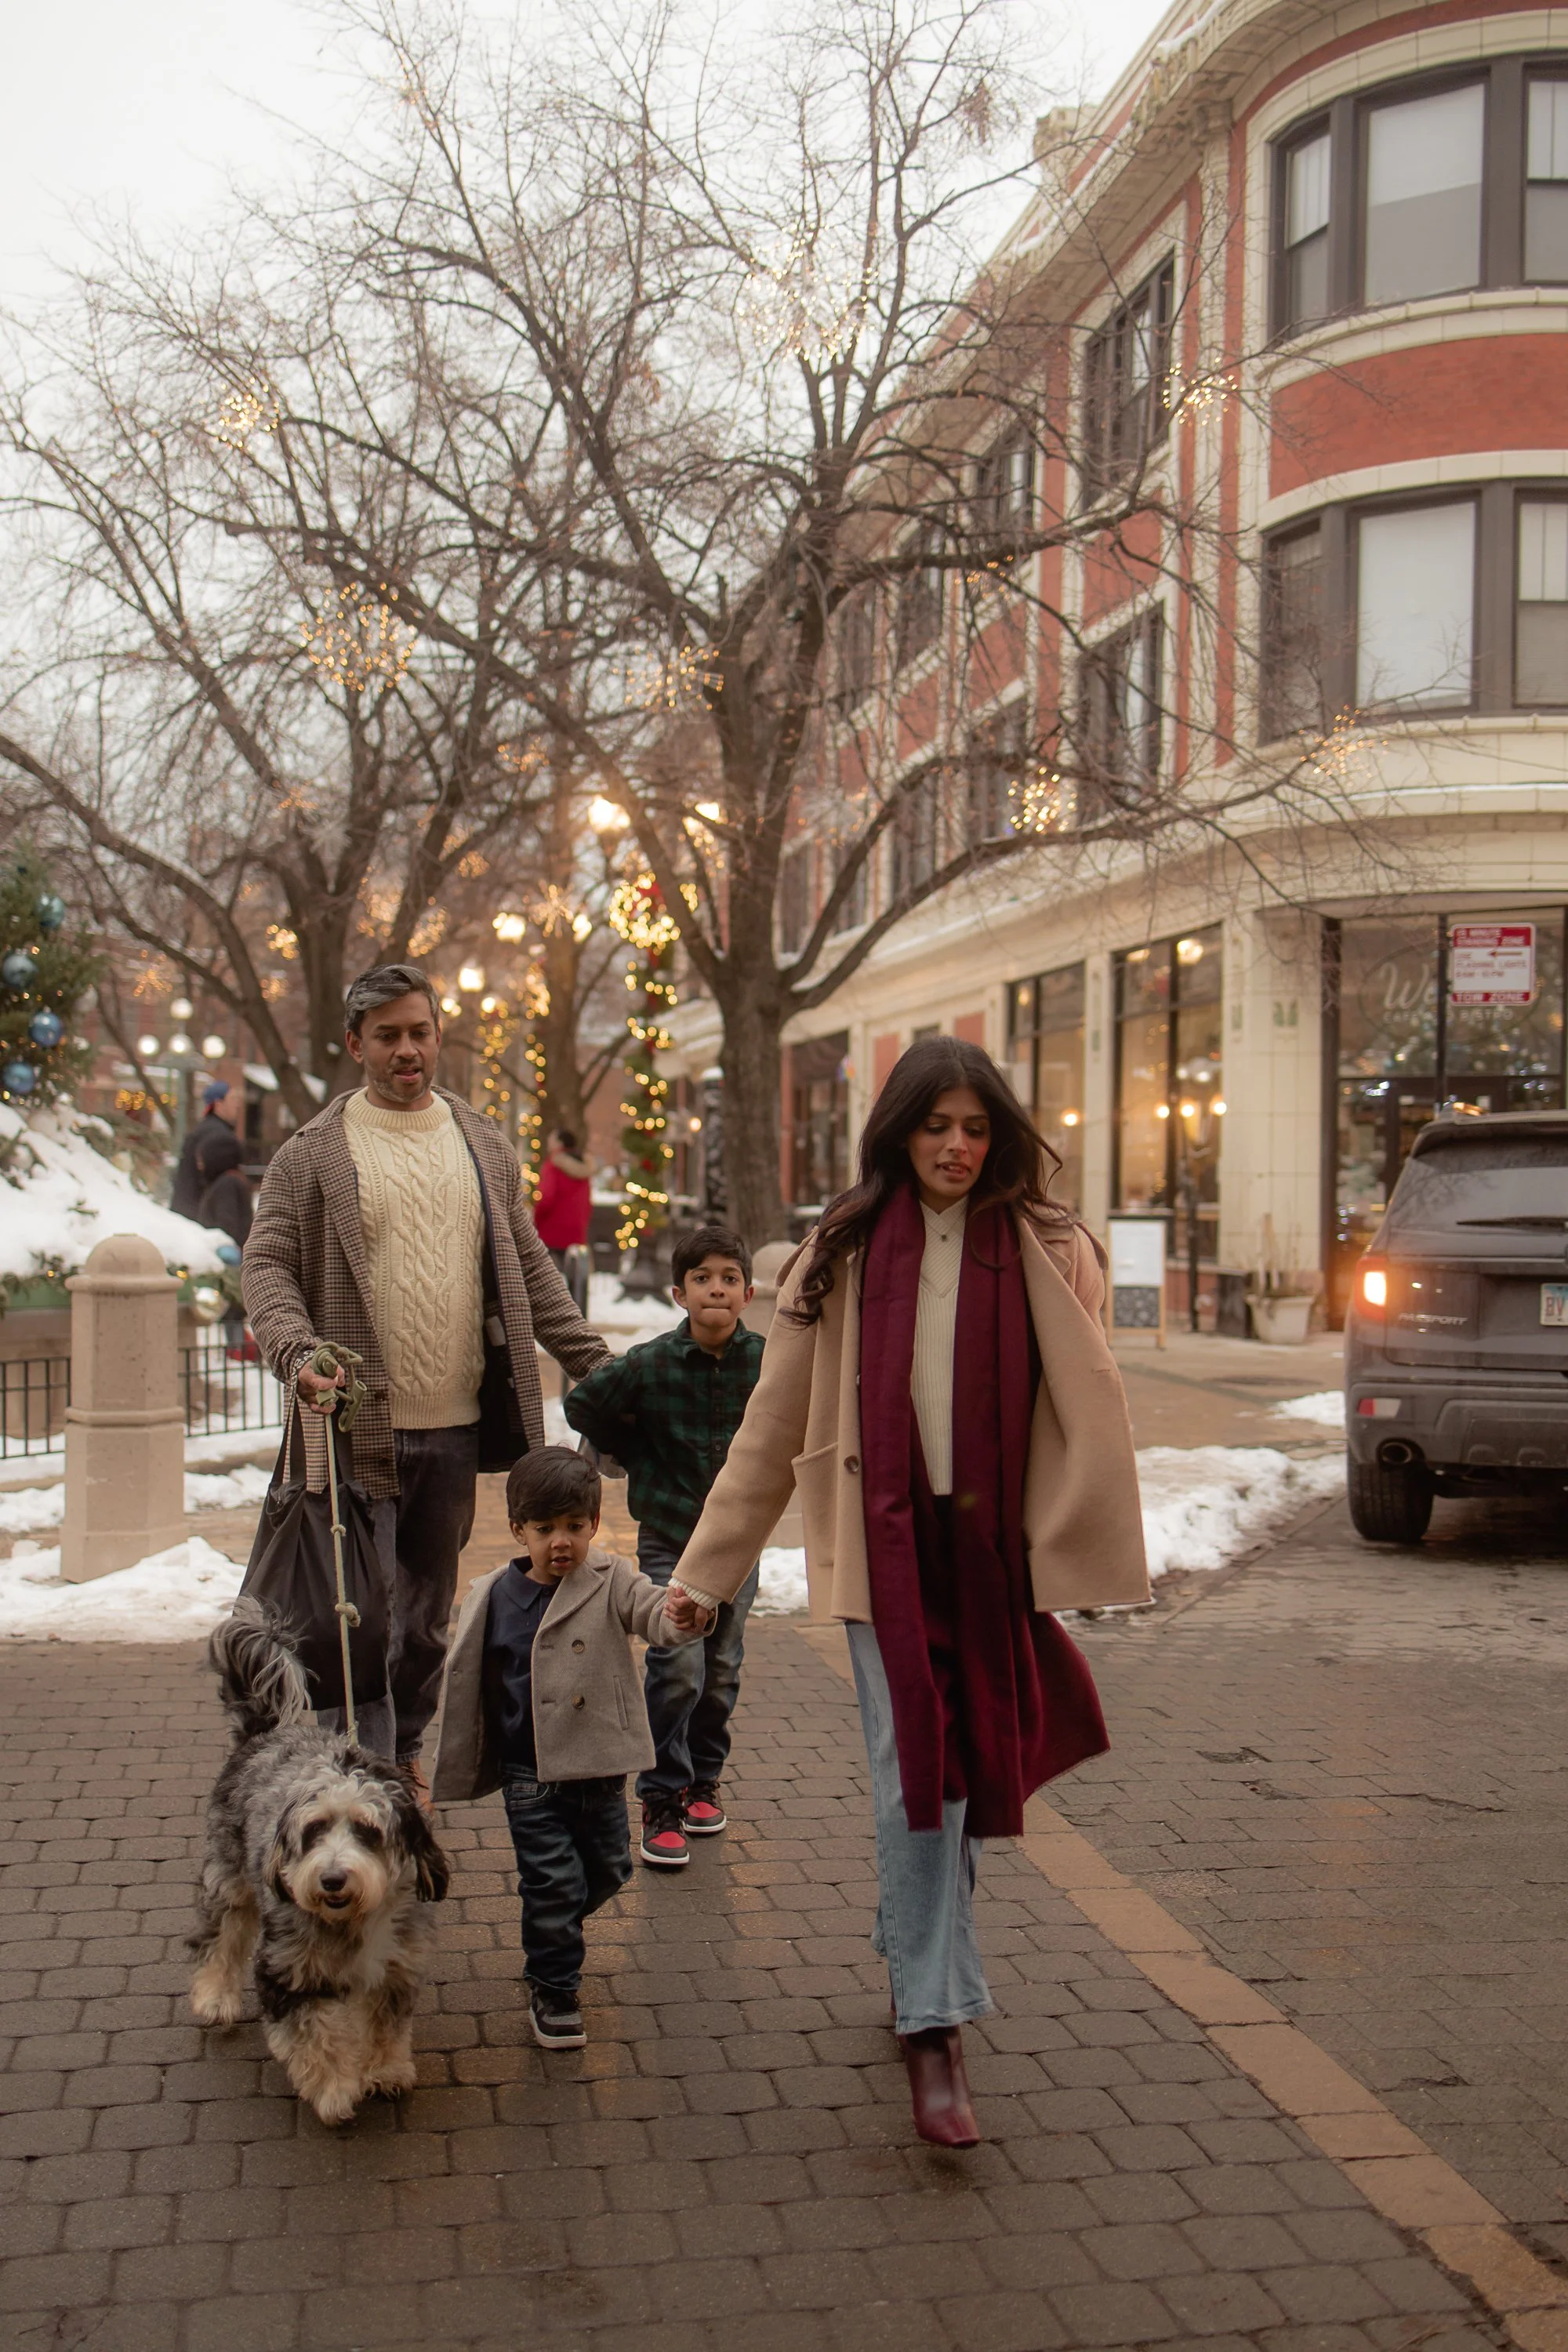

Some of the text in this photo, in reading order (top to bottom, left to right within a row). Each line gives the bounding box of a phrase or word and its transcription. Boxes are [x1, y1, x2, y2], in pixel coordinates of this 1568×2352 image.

[1456, 993, 1523, 1002] TOW ZONE
[1398, 1312, 1468, 1325] PASSPORT
